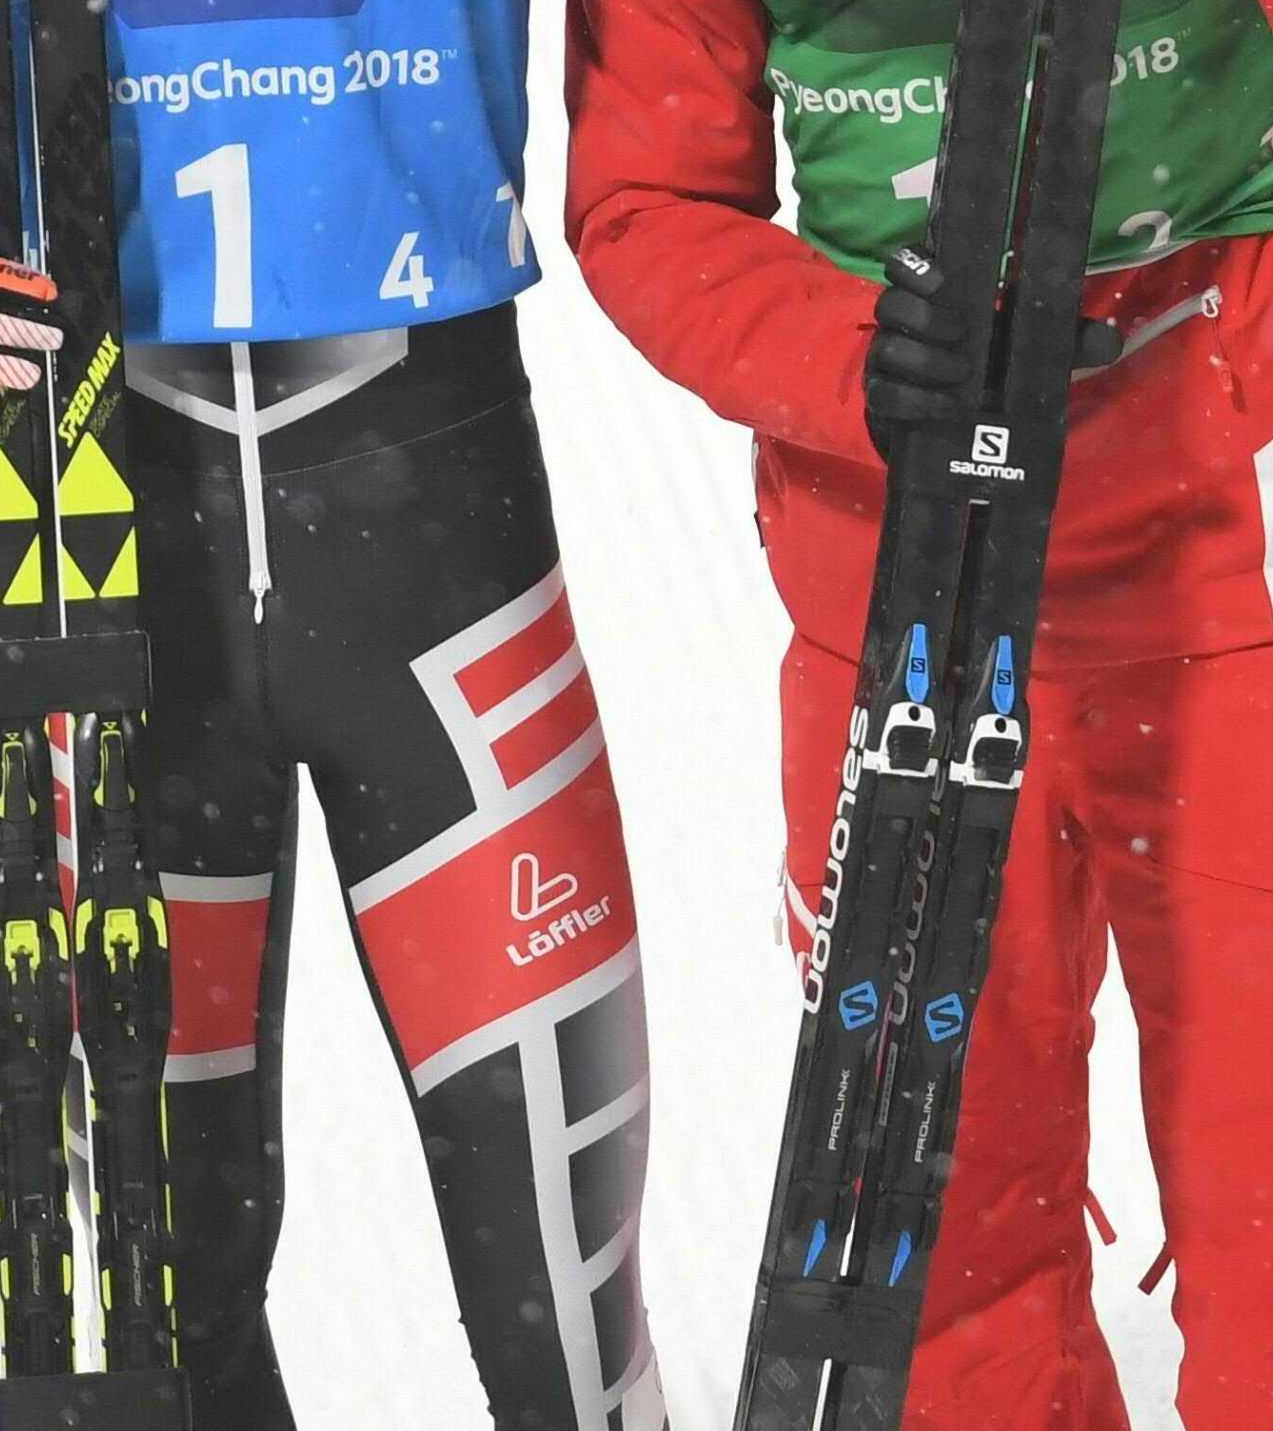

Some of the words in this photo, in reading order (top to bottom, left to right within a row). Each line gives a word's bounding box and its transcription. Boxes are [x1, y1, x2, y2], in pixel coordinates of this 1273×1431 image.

[343, 49, 440, 94] 2018
[175, 143, 253, 329] 1
[379, 231, 434, 308] 4
[949, 459, 1025, 482] salomon
[802, 706, 870, 1015] salomon
